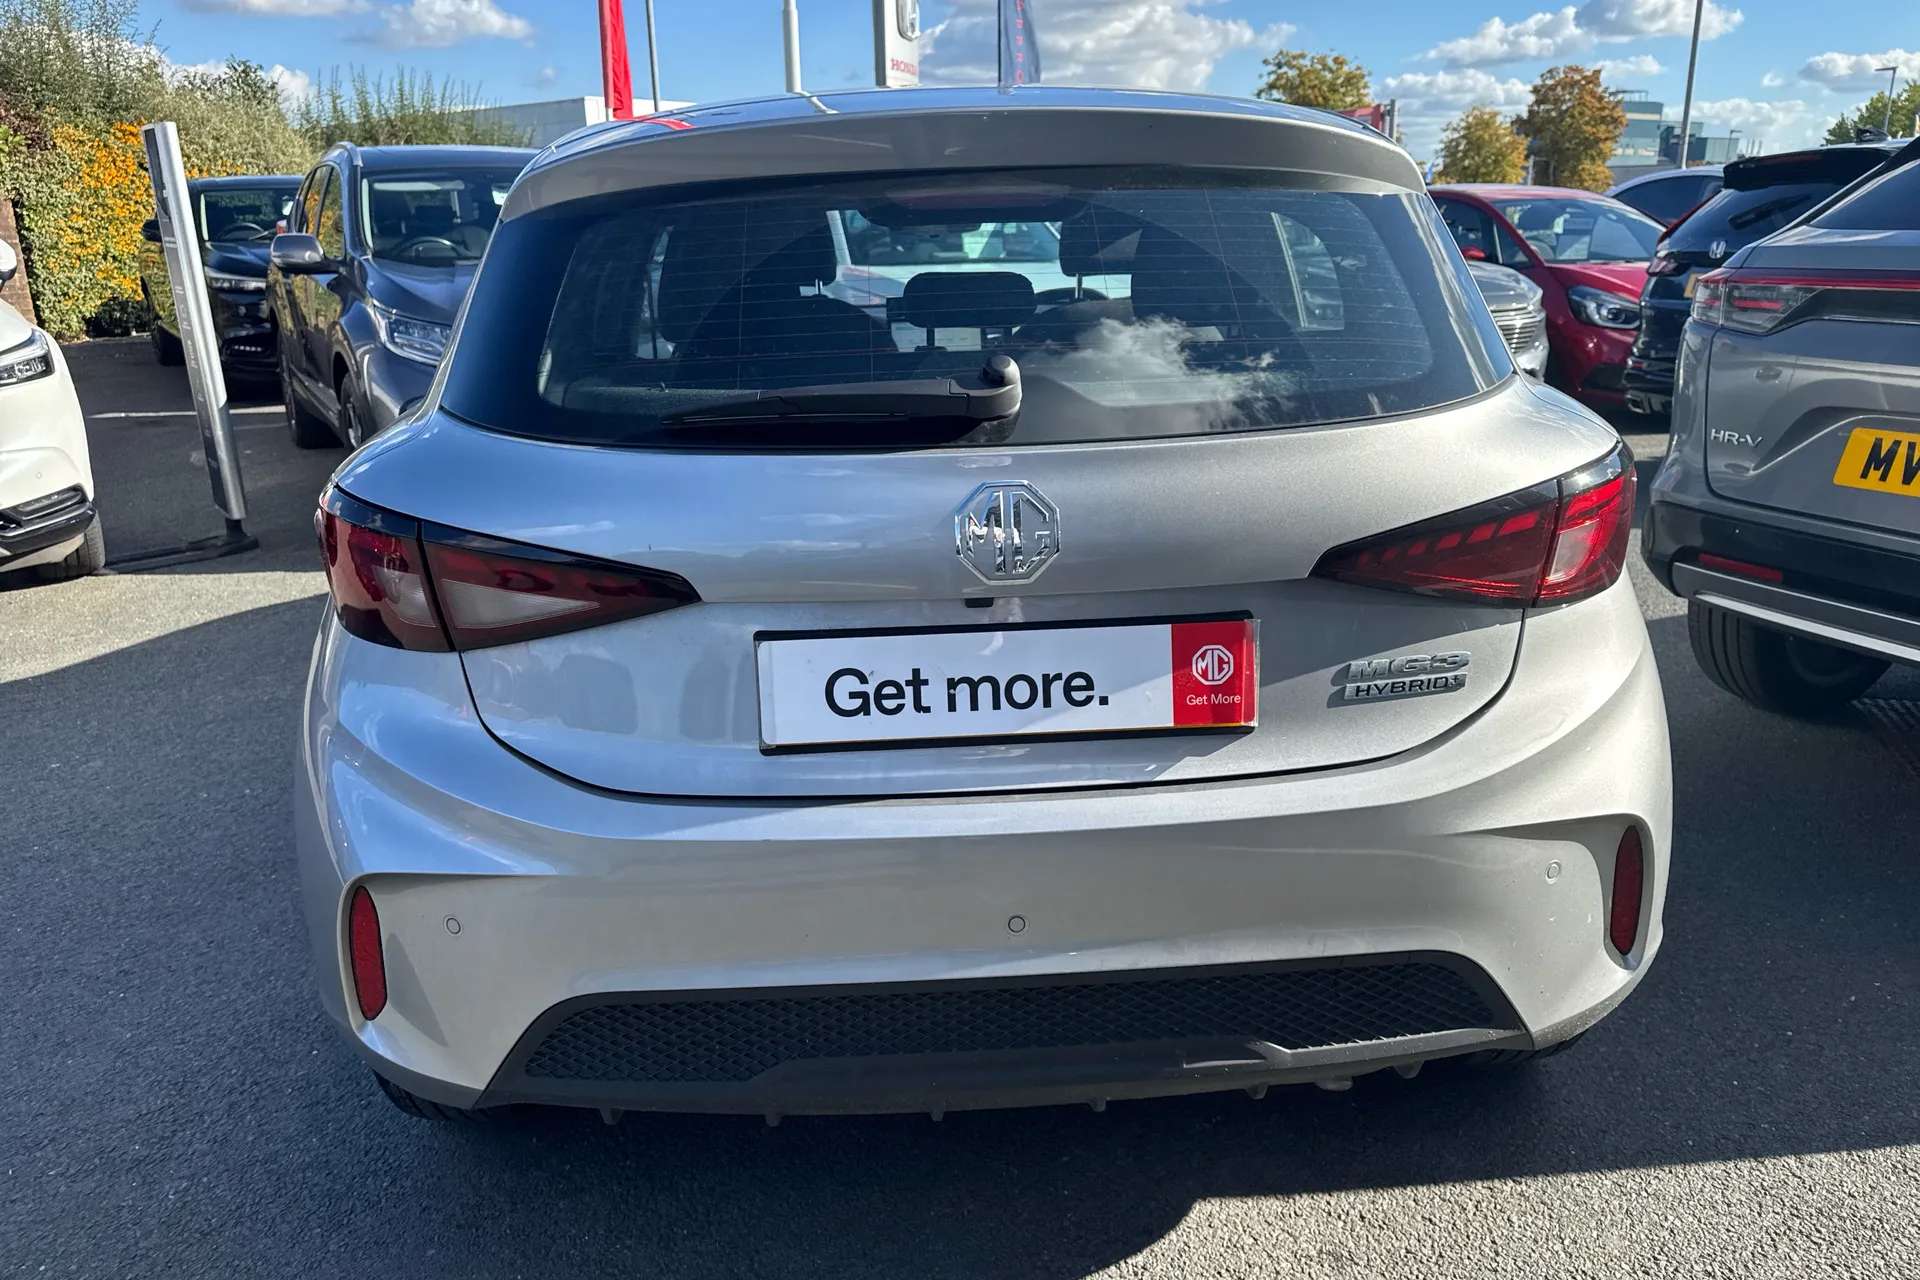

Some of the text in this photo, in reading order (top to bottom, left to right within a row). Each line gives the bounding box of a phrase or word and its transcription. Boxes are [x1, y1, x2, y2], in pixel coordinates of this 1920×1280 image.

[1710, 428, 1763, 447] HR-V
[964, 490, 1051, 576] MG
[1196, 648, 1231, 682] MG
[1348, 651, 1472, 680] MG3
[824, 667, 1109, 718] Get more.
[1186, 693, 1241, 706] Get More
[1355, 675, 1461, 698] HYBRID+
